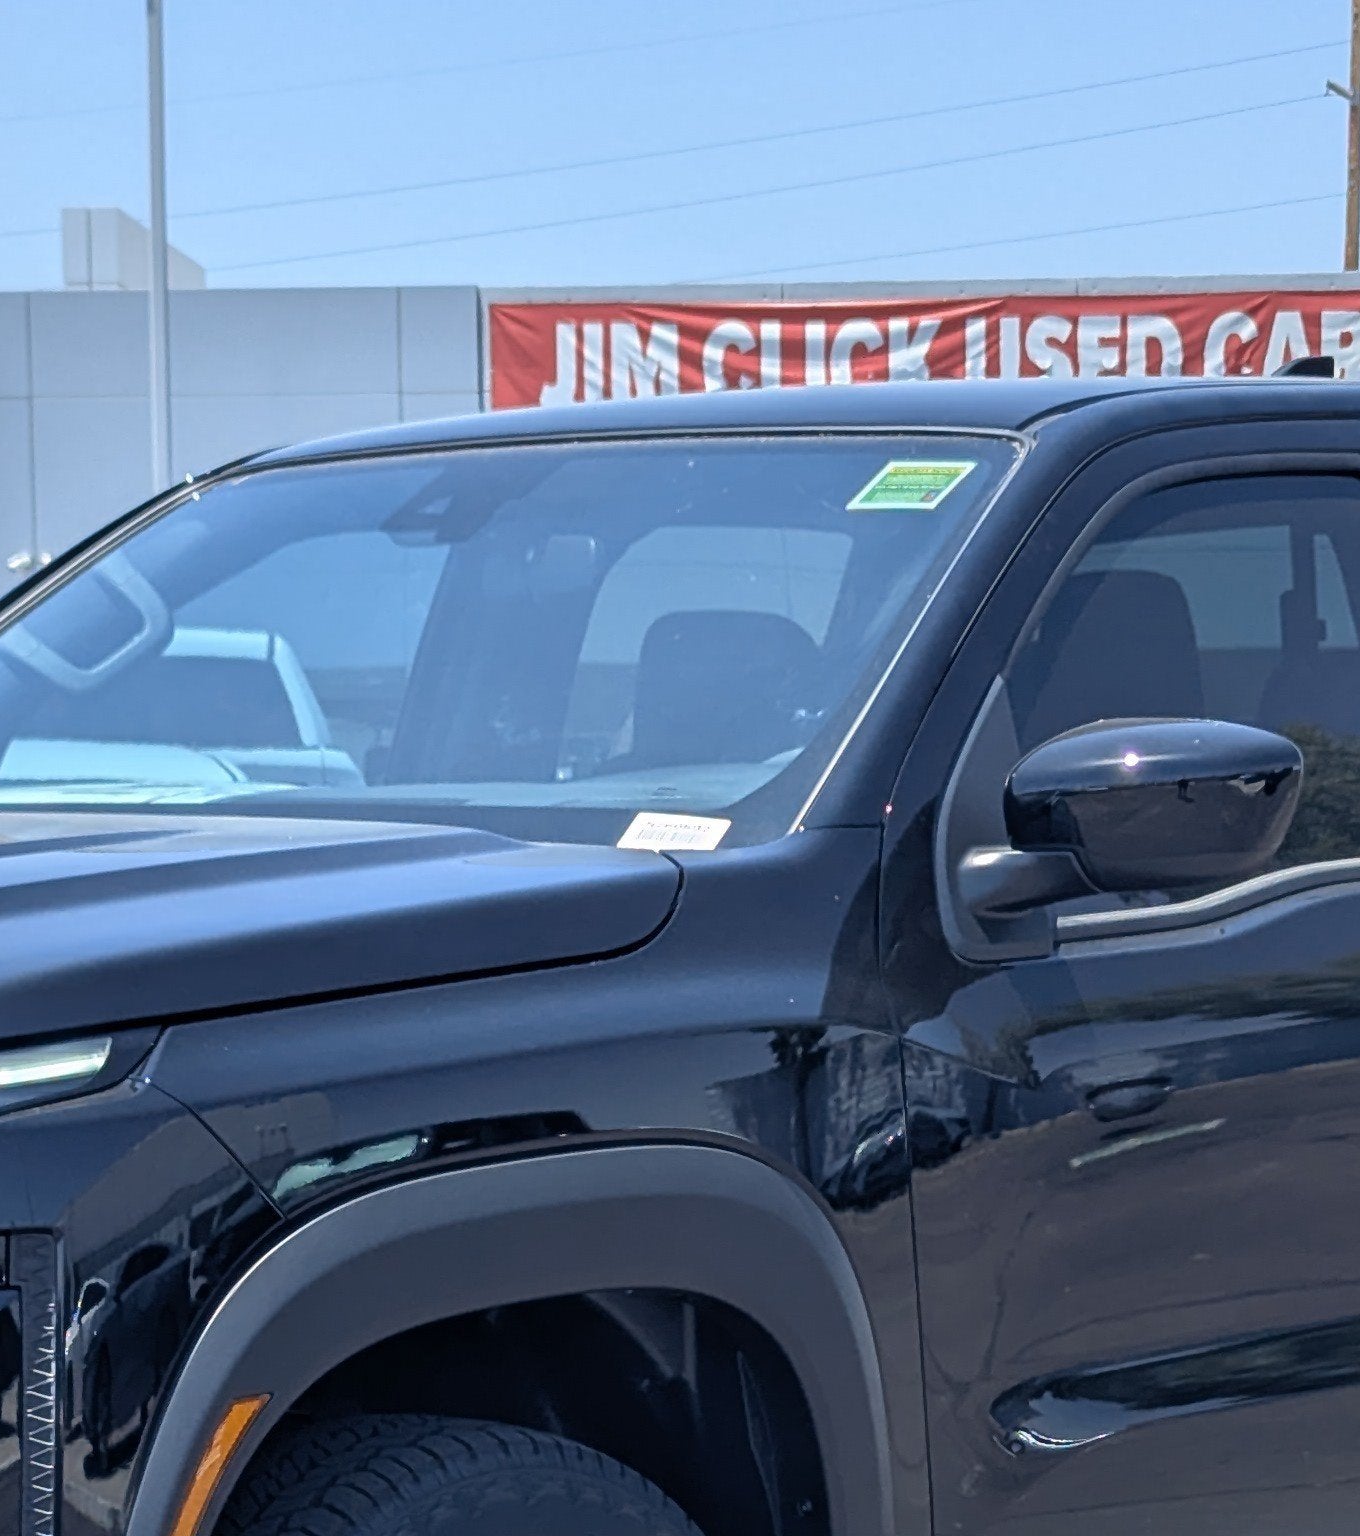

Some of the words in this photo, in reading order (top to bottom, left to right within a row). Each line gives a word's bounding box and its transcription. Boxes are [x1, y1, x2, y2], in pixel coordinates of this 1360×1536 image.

[540, 319, 680, 403] JIM
[702, 317, 943, 392] CLICK
[965, 314, 1184, 380] USED
